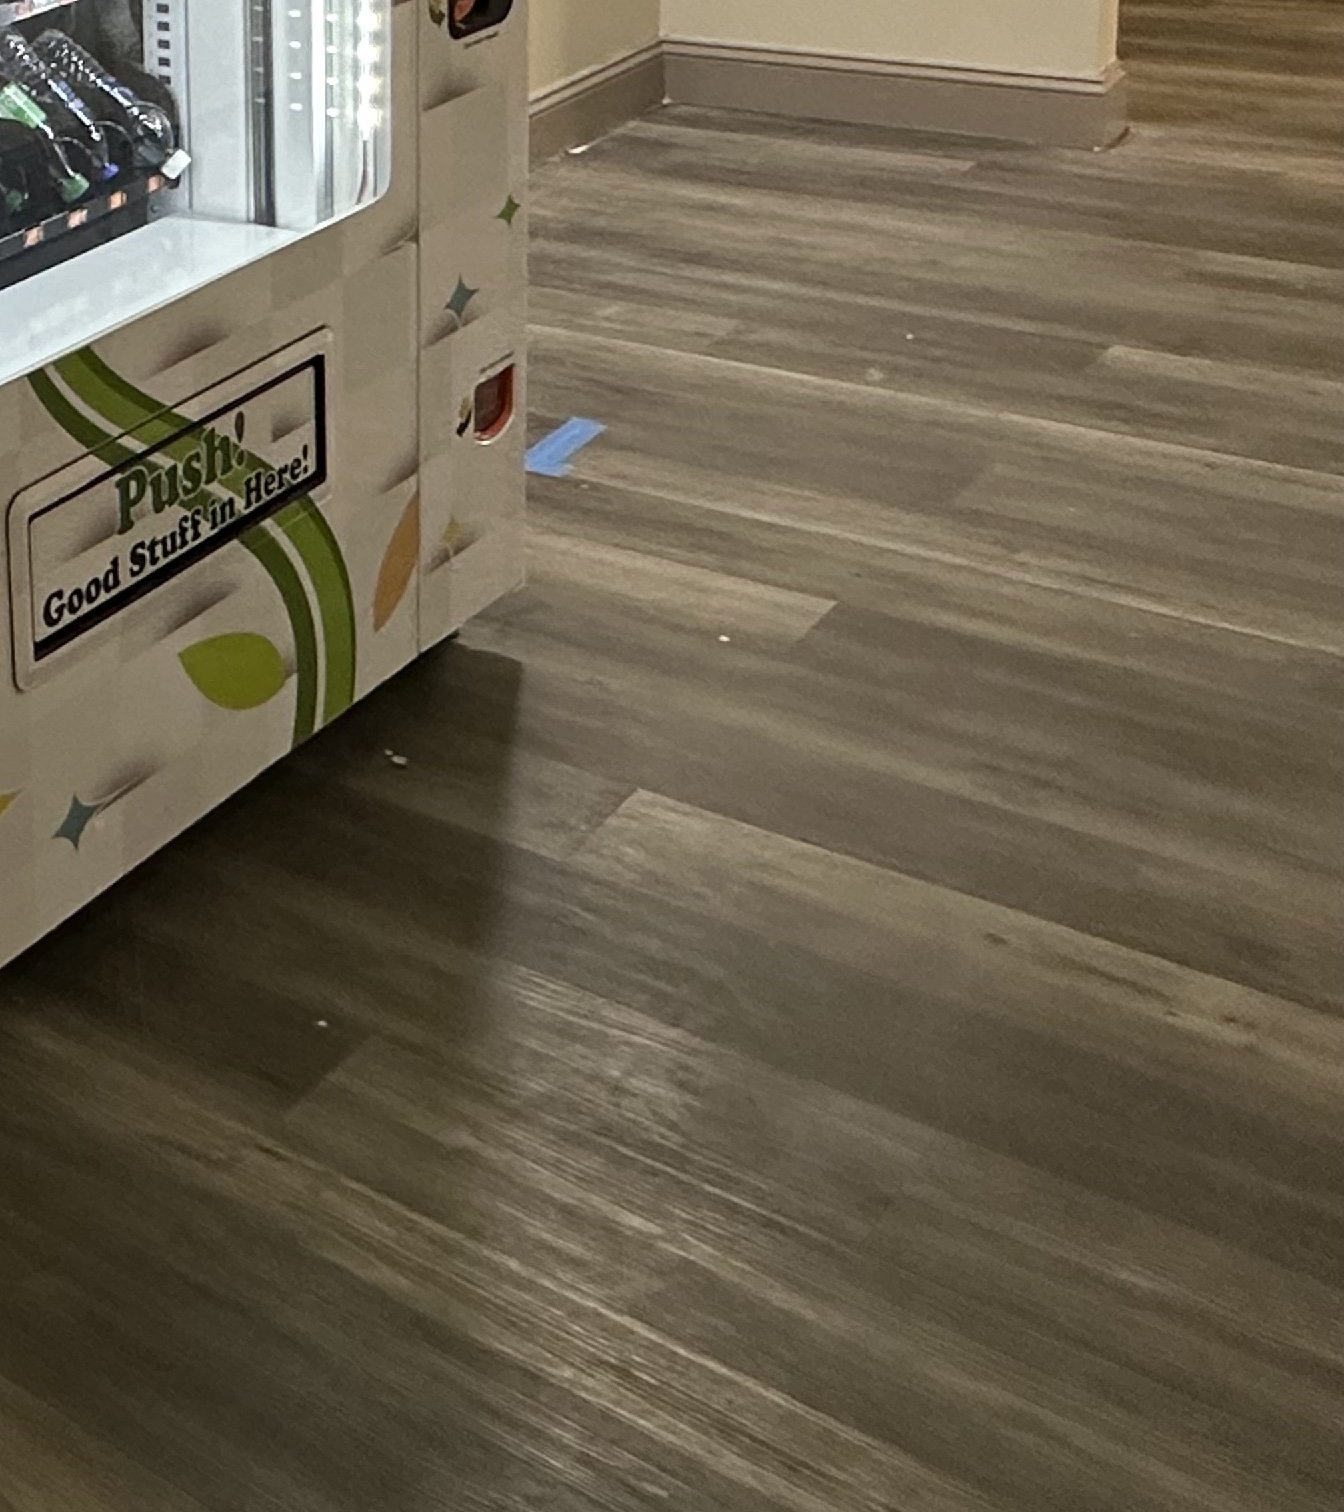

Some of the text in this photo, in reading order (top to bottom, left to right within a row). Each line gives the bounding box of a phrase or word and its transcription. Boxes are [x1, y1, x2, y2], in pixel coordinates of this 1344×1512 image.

[43, 443, 310, 628] Good Stuff in Here!
[115, 410, 247, 536] Push!
